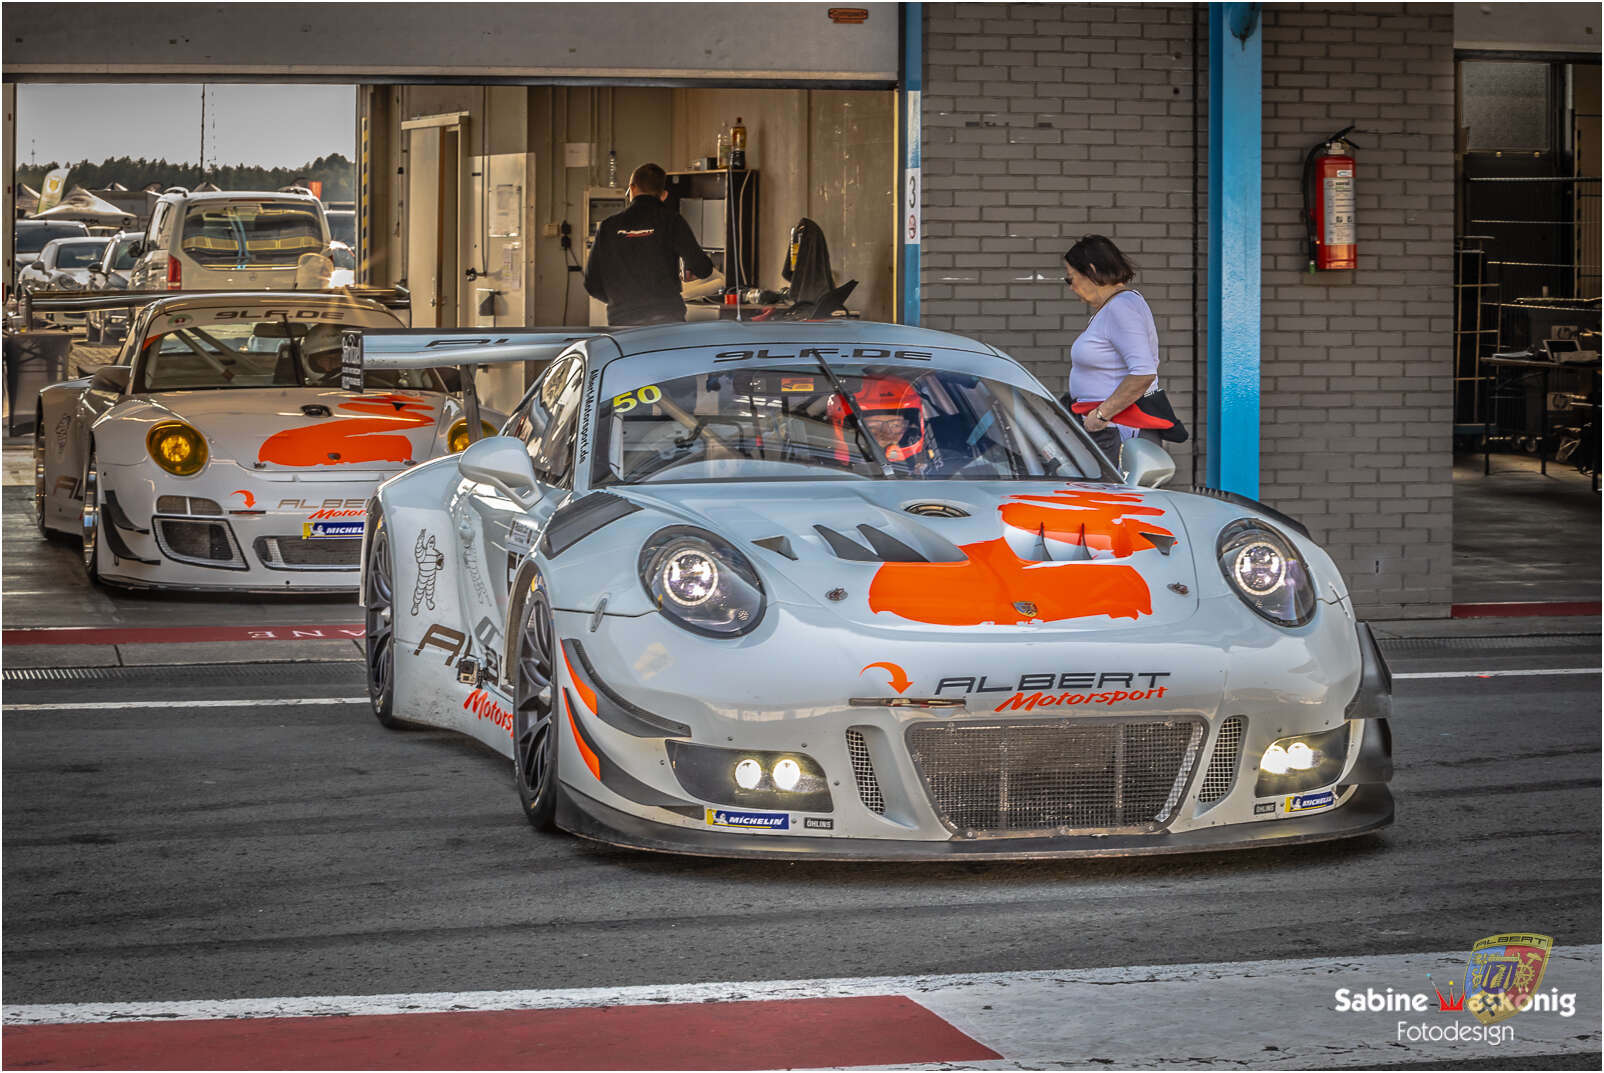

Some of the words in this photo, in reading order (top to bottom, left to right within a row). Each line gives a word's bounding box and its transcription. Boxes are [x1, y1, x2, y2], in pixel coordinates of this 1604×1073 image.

[713, 348, 932, 363] 9LF.DE
[613, 385, 662, 413] 50
[277, 498, 369, 509] ALBE
[934, 672, 1171, 695] ALBERT
[994, 686, 1169, 712] Motorsport
[729, 816, 785, 826] MICHELIN
